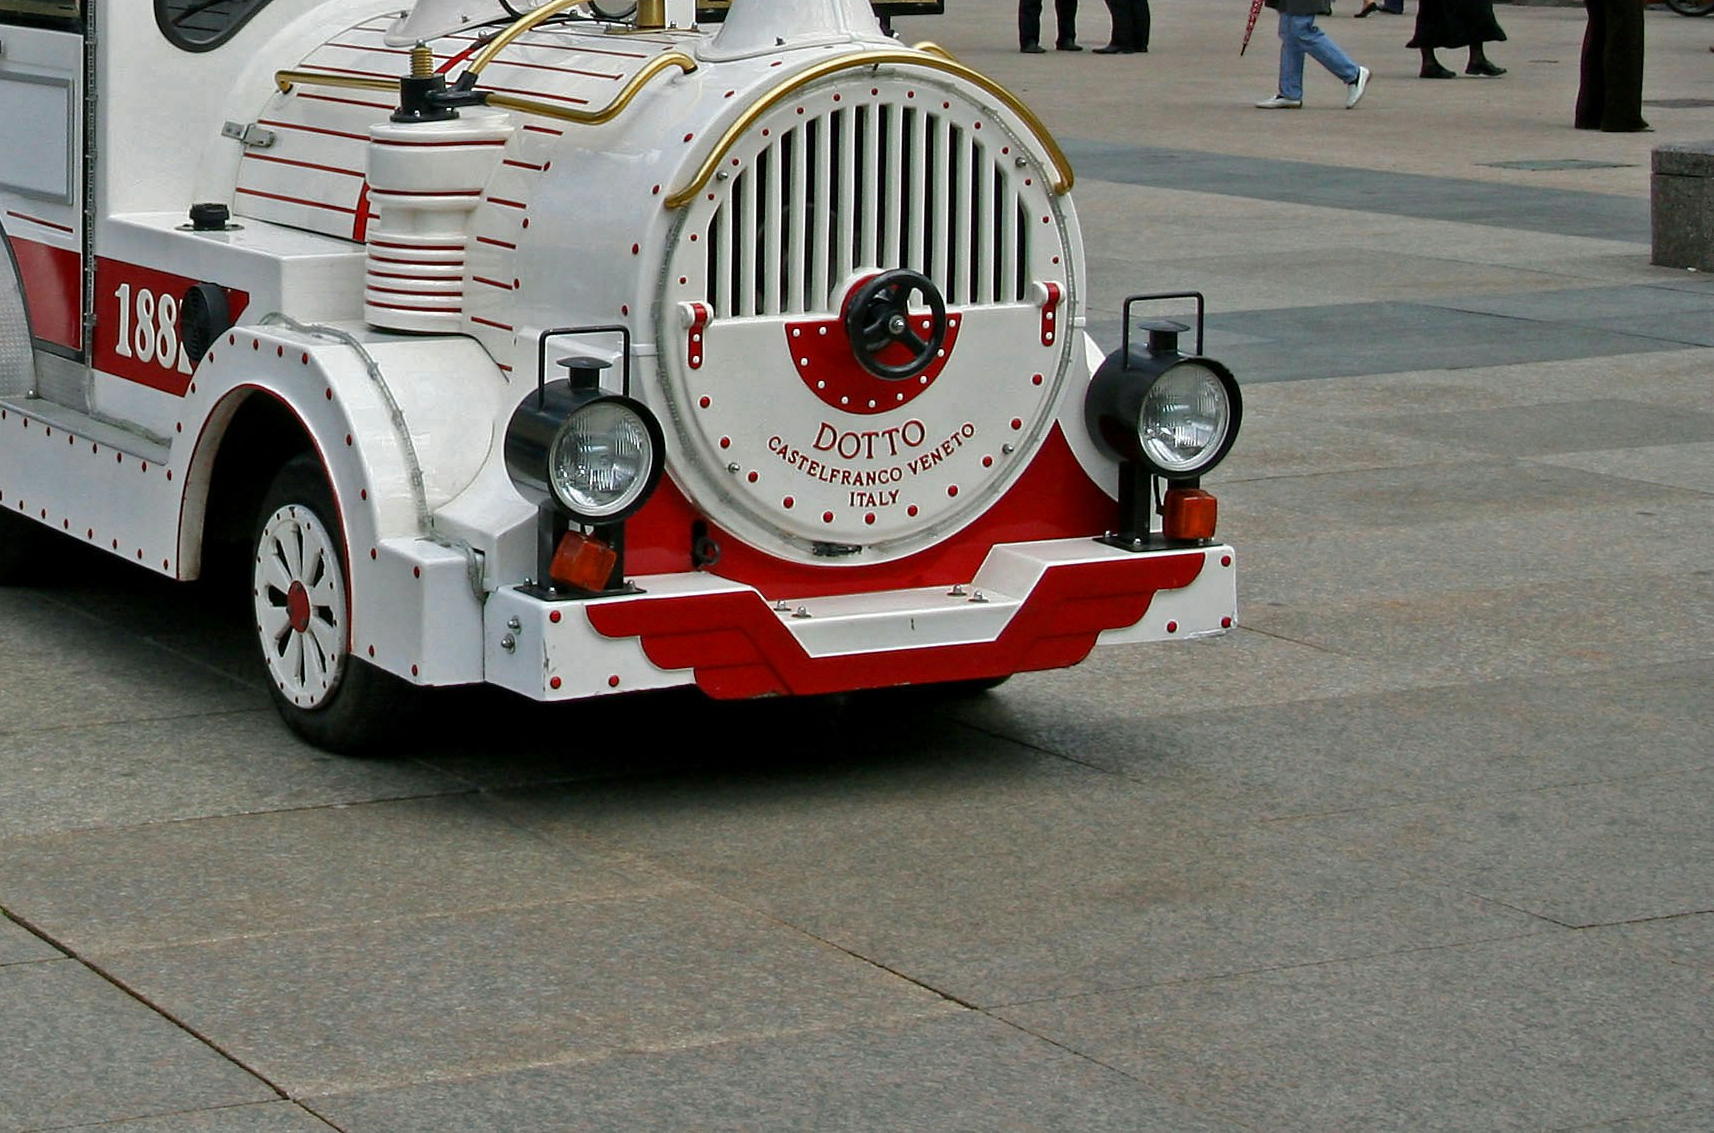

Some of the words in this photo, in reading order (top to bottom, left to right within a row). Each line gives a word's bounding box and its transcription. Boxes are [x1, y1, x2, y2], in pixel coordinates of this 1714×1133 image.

[767, 435, 903, 487] CASTELFRANCO
[906, 423, 975, 476] VENETO
[813, 419, 925, 459] DOTTO
[849, 489, 900, 507] ITALY
